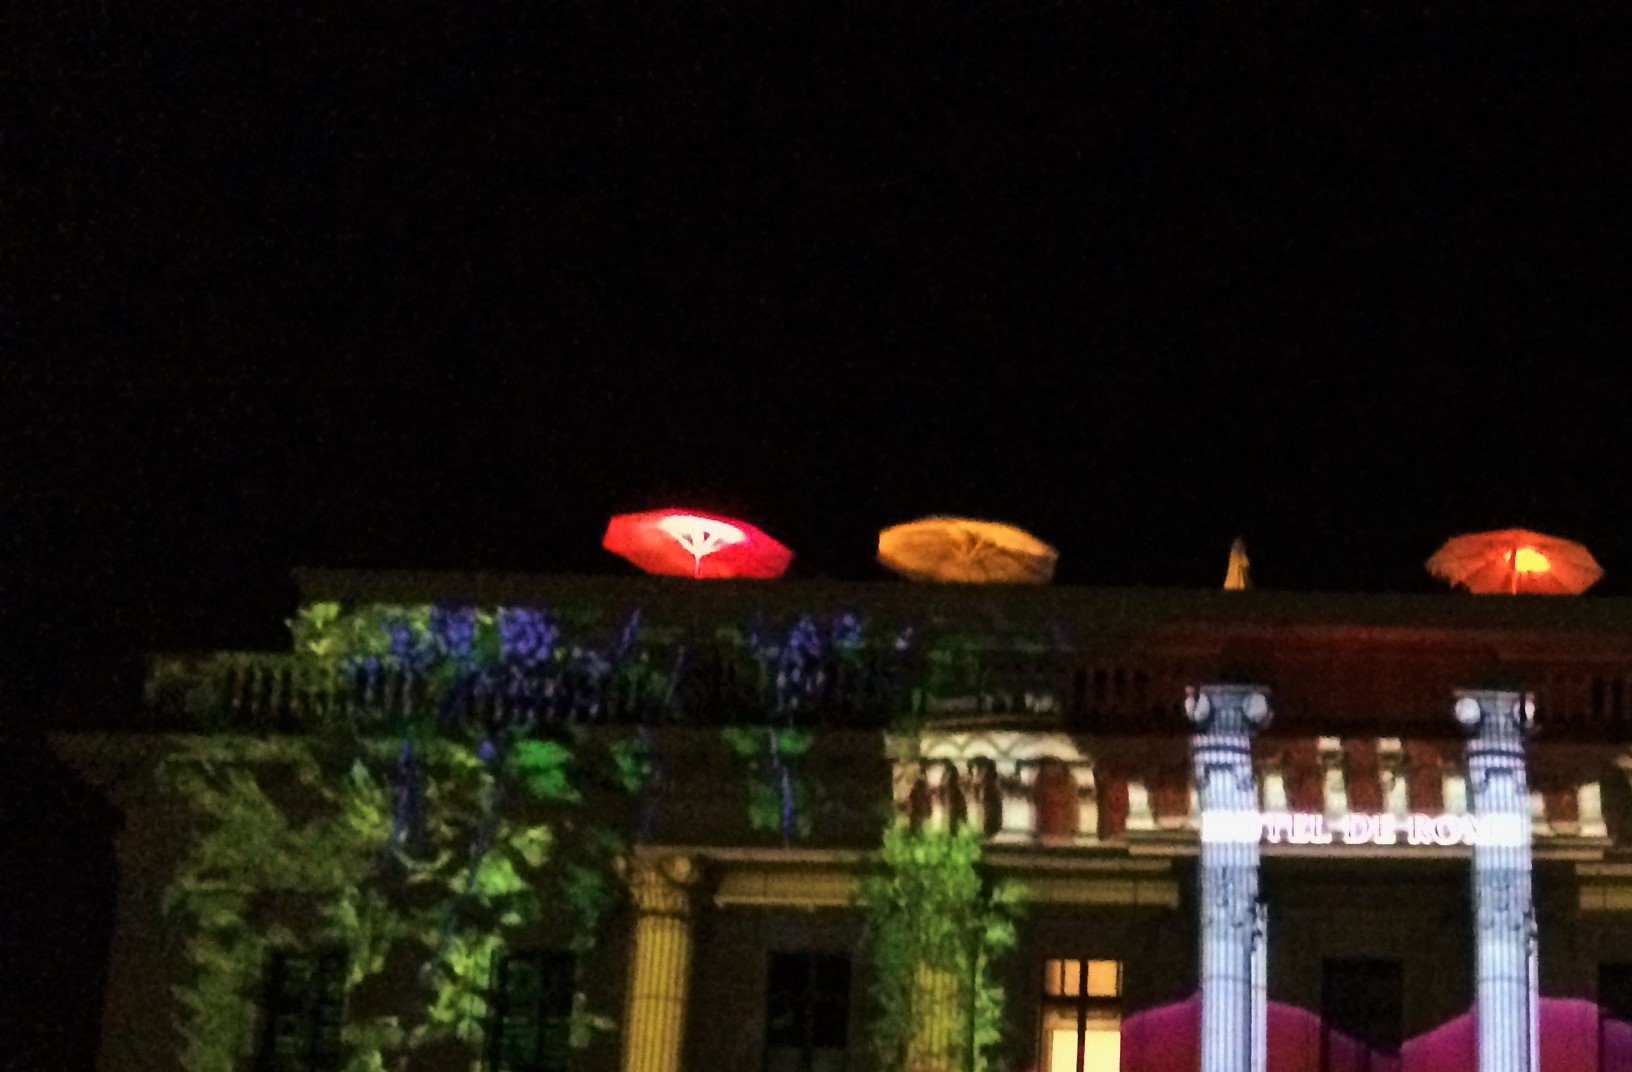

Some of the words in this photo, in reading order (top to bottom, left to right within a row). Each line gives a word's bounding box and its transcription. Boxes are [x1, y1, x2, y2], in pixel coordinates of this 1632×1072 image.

[1203, 812, 1332, 844] TEL
[1344, 813, 1396, 845] DE
[1408, 814, 1522, 846] RO
